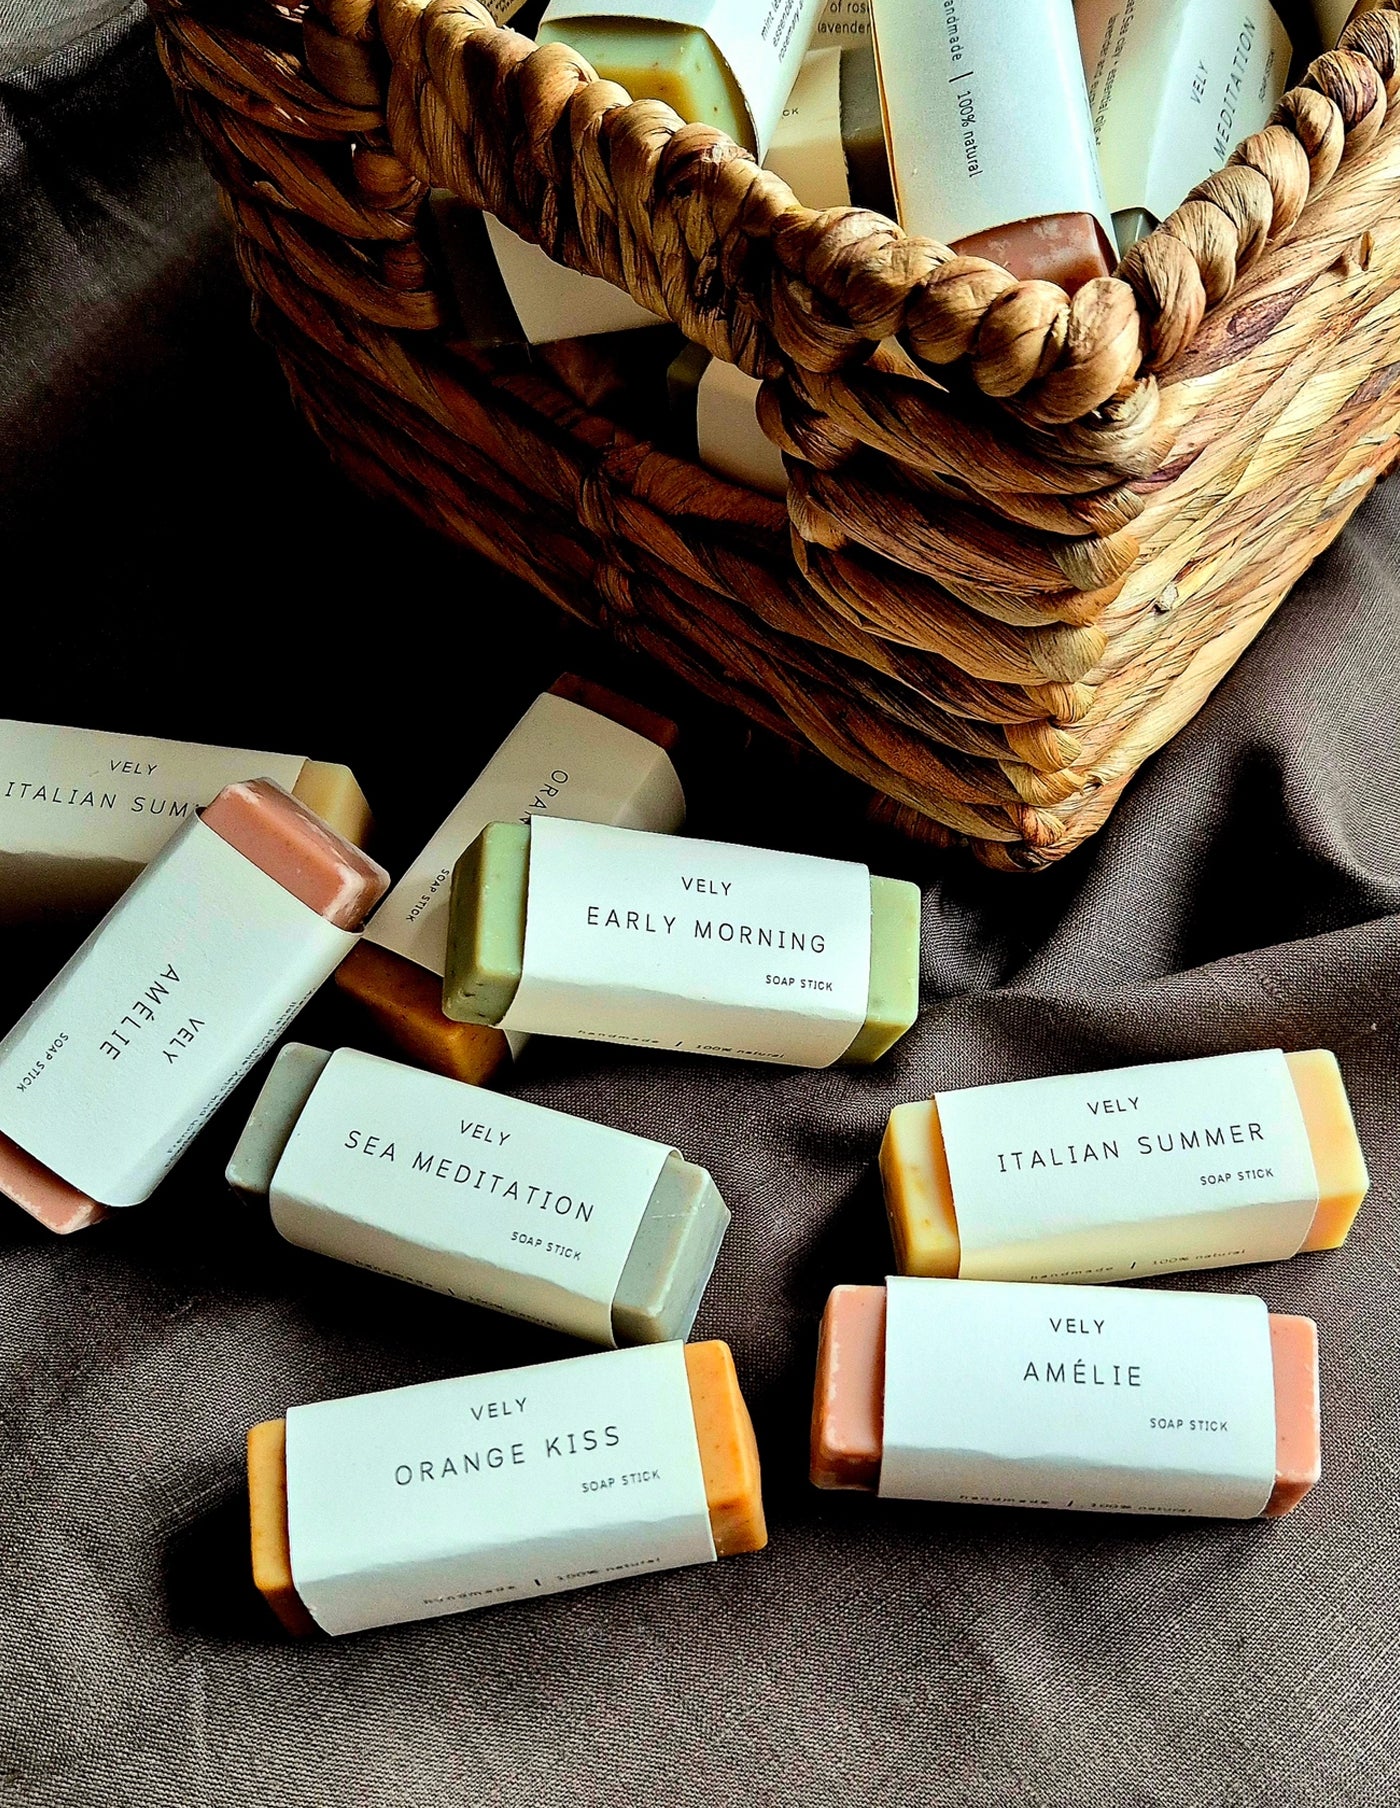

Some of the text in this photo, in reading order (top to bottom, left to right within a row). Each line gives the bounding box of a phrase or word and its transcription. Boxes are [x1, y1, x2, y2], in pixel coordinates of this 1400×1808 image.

[830, 1, 842, 13] of
[1190, 59, 1208, 105] VELY
[1212, 16, 1256, 163] MEDITATION
[957, 90, 976, 128] 100%
[963, 131, 983, 178] natural
[109, 760, 158, 776] VELY
[5, 782, 199, 818] ITALIAN SUM
[406, 868, 450, 921] SOAP STICK
[681, 876, 731, 896] VELY
[587, 906, 828, 954] EARLY MORNING
[765, 974, 833, 992] SOAP STICK
[99, 963, 181, 1061] AMÉLIE
[163, 1018, 205, 1063] VELY
[16, 1032, 69, 1093] SOAP STICK
[1087, 1096, 1140, 1116] VELY
[460, 1120, 511, 1147] VELY
[998, 1122, 1264, 1173] ITALIAN SUMMER
[344, 1130, 594, 1222] SEA MEDITATION
[1200, 1167, 1274, 1186] SOAP STICK
[511, 1231, 581, 1260] SOAP STICK
[1049, 1318, 1106, 1335] VELY
[1023, 1359, 1143, 1388] AMÉLIE
[470, 1397, 528, 1421] VELY
[1150, 1417, 1229, 1433] SOAP STICK
[395, 1425, 621, 1486] ORANGE KISS
[582, 1470, 661, 1494] SOAP STICK
